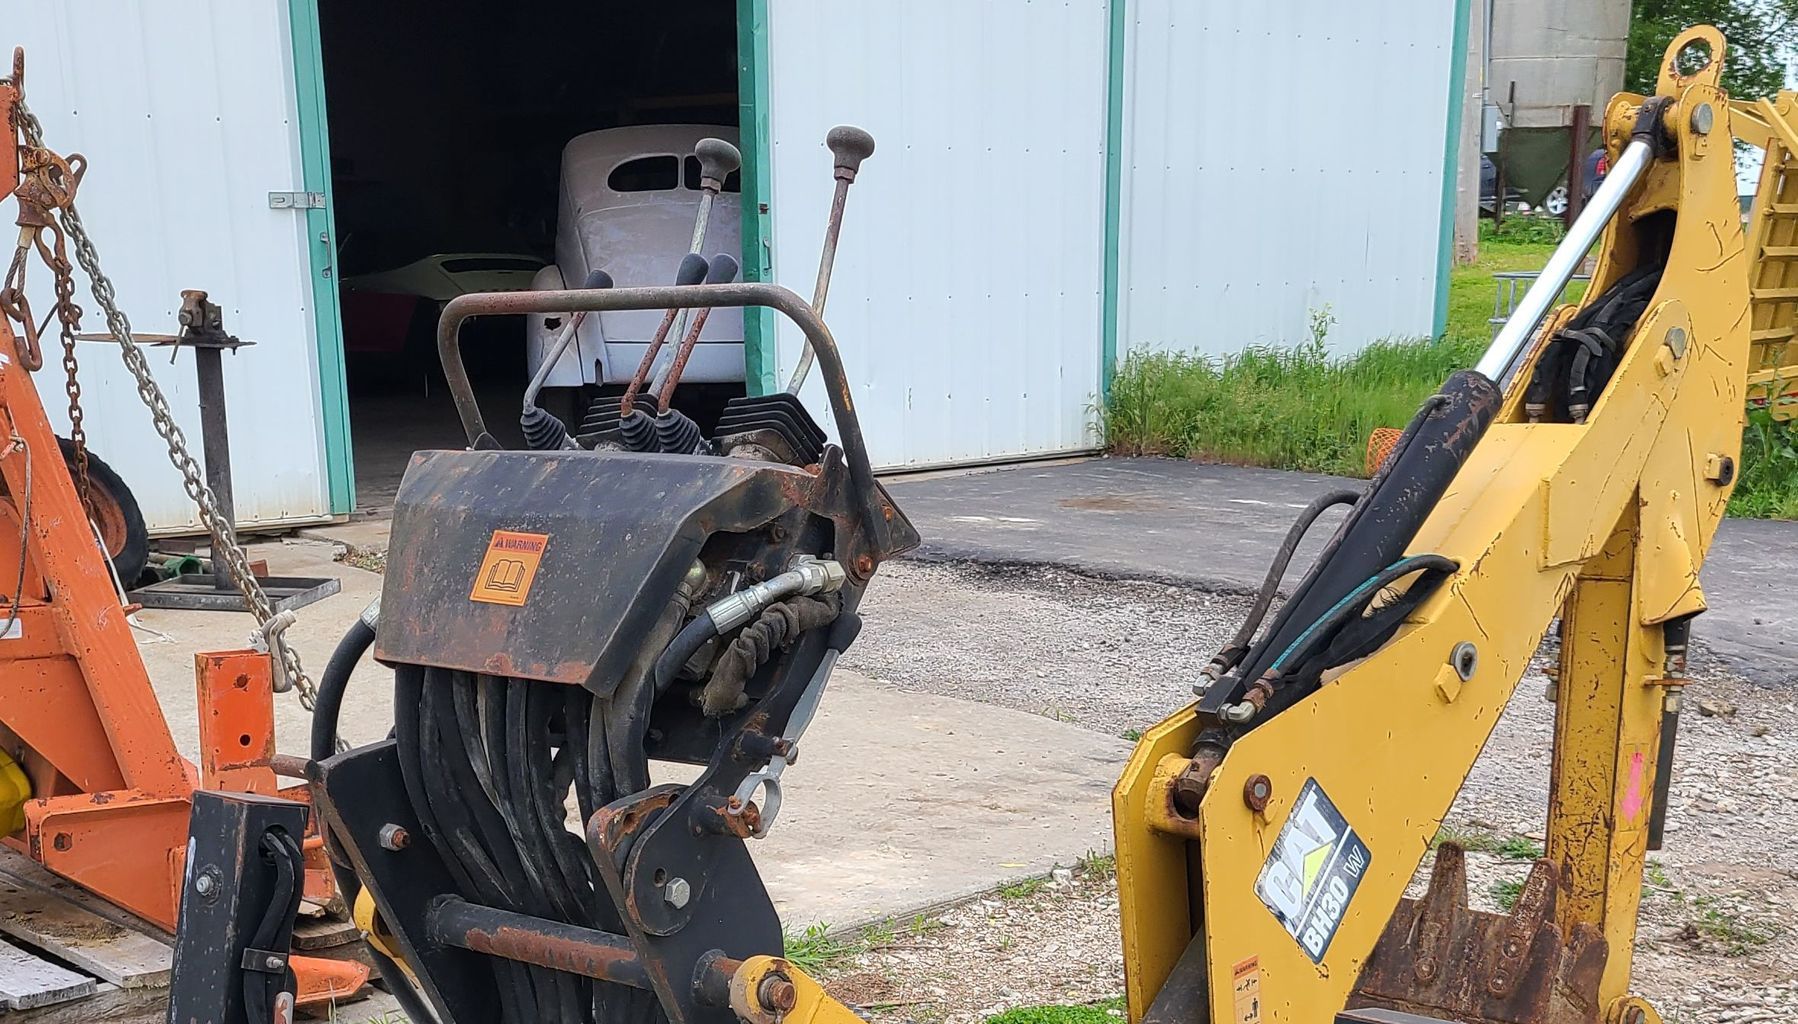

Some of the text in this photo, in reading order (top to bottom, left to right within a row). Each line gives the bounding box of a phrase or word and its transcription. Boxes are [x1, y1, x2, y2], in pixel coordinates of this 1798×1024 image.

[505, 538, 543, 552] WARNING
[1265, 789, 1337, 920] CAT
[1303, 875, 1349, 958] BH30
